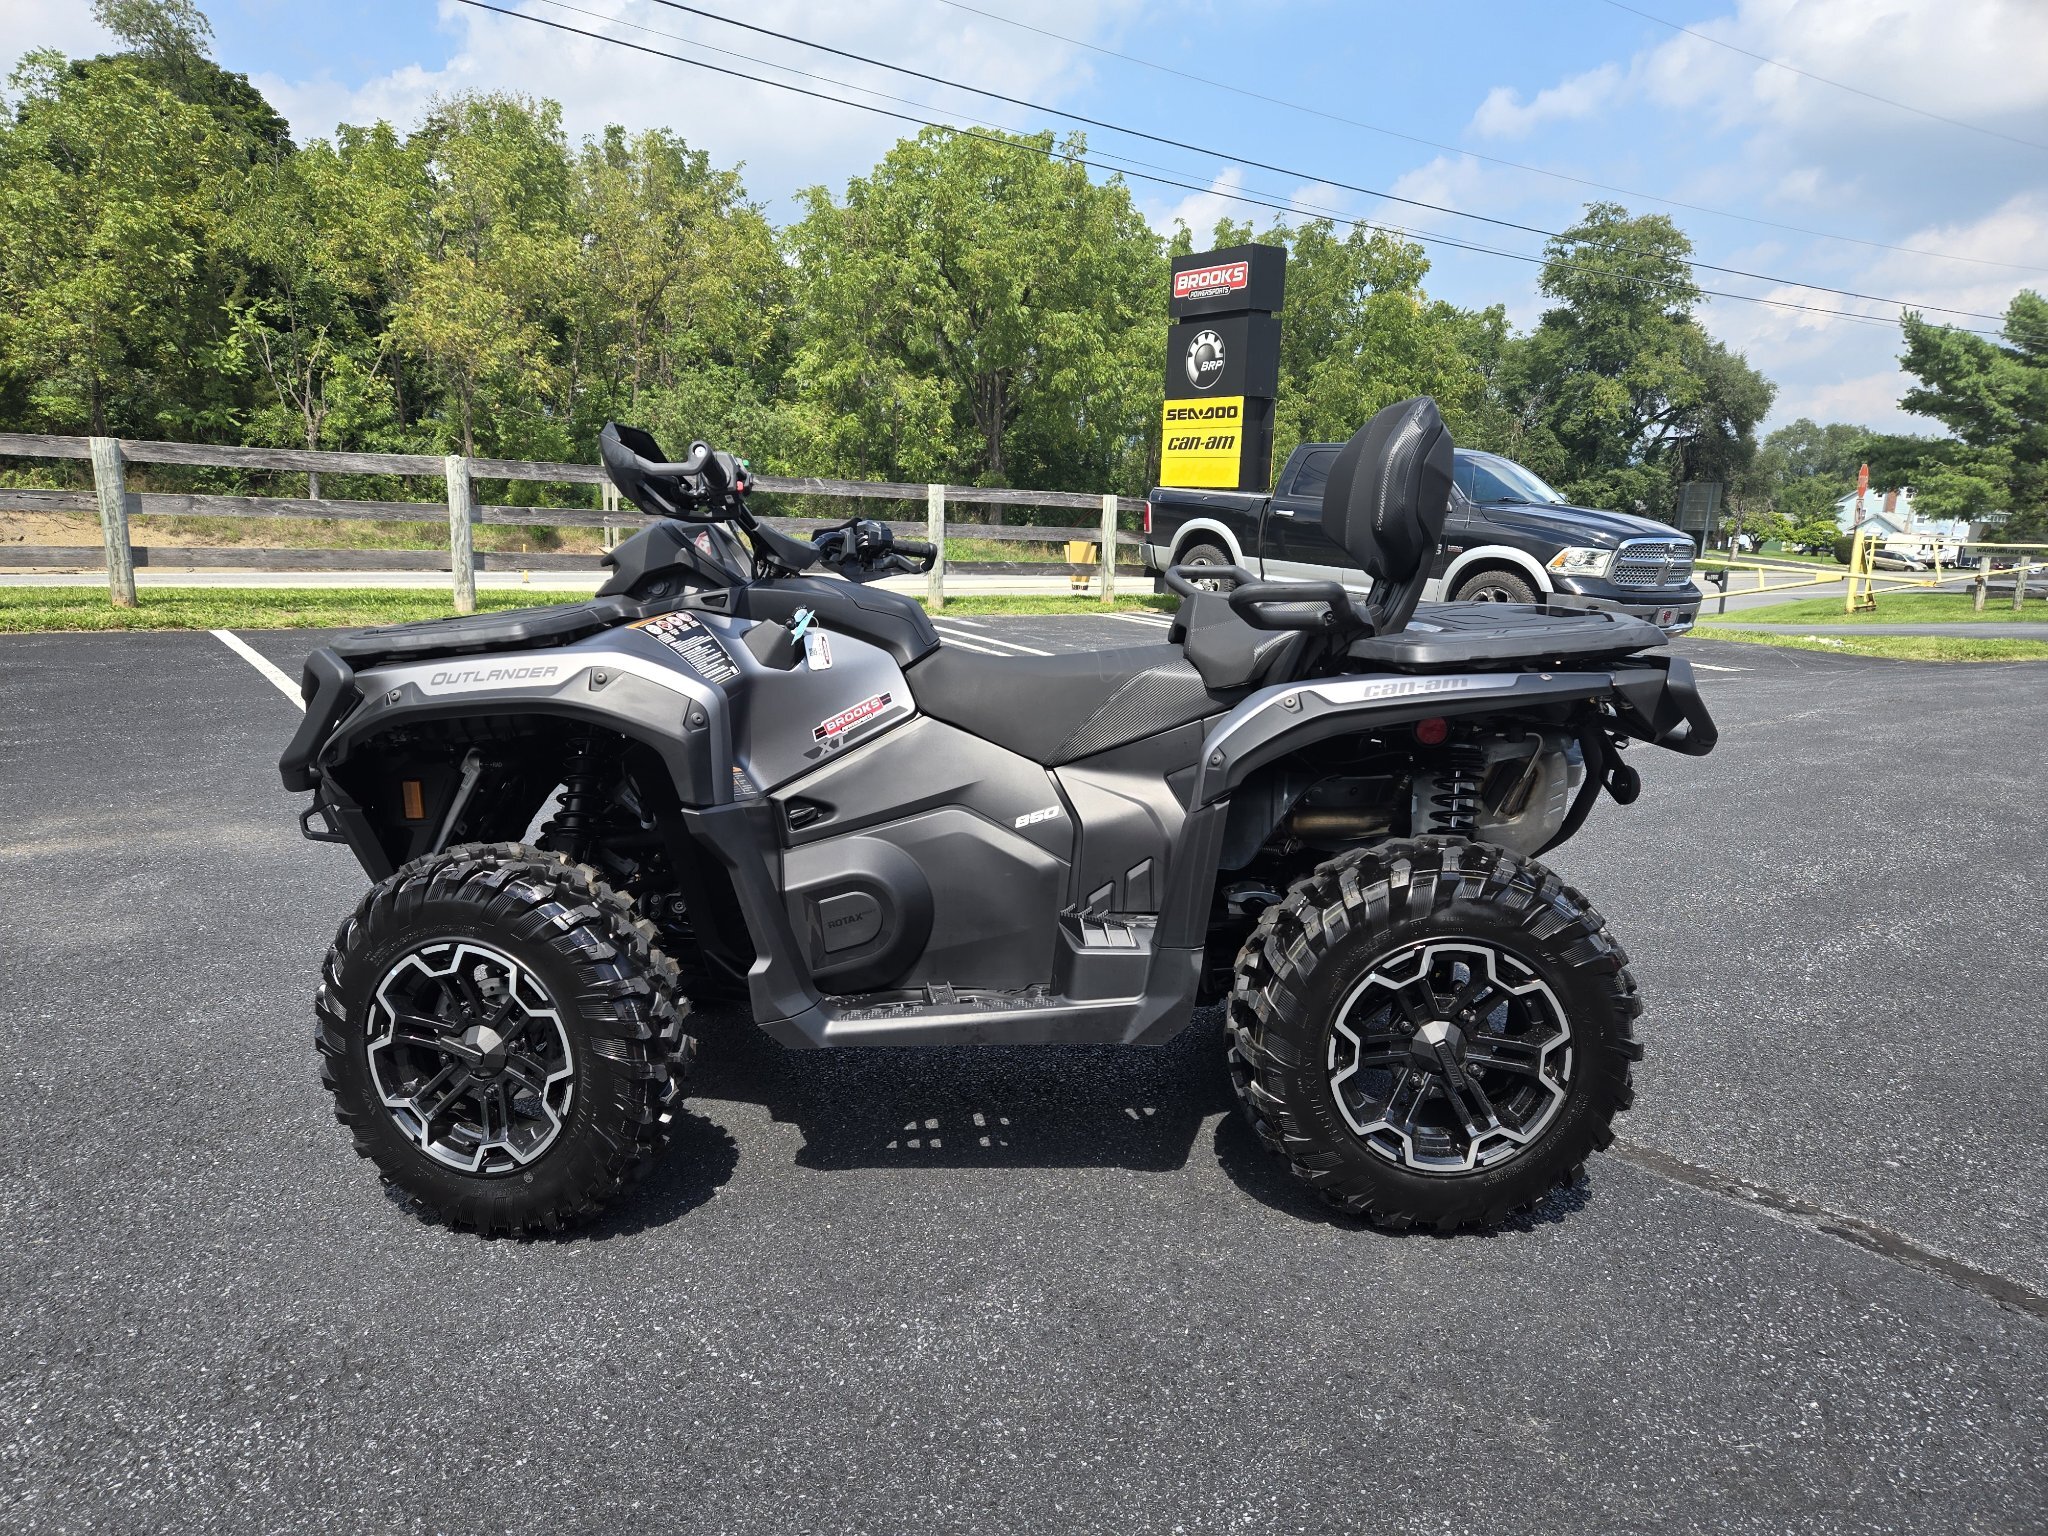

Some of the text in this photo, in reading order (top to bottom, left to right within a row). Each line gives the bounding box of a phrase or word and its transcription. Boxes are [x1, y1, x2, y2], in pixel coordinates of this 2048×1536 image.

[1177, 267, 1245, 290] BROOKS
[1189, 286, 1230, 299] POWERSPORTS
[1200, 359, 1224, 372] BRP
[1167, 435, 1235, 450] can-am
[1976, 547, 2019, 555] WAREHOUSE
[431, 666, 559, 685] OUTLANDER
[1364, 678, 1468, 697] can-am
[826, 699, 880, 731] BROOKS
[1015, 806, 1060, 828] 850
[827, 912, 864, 929] ROTAX
